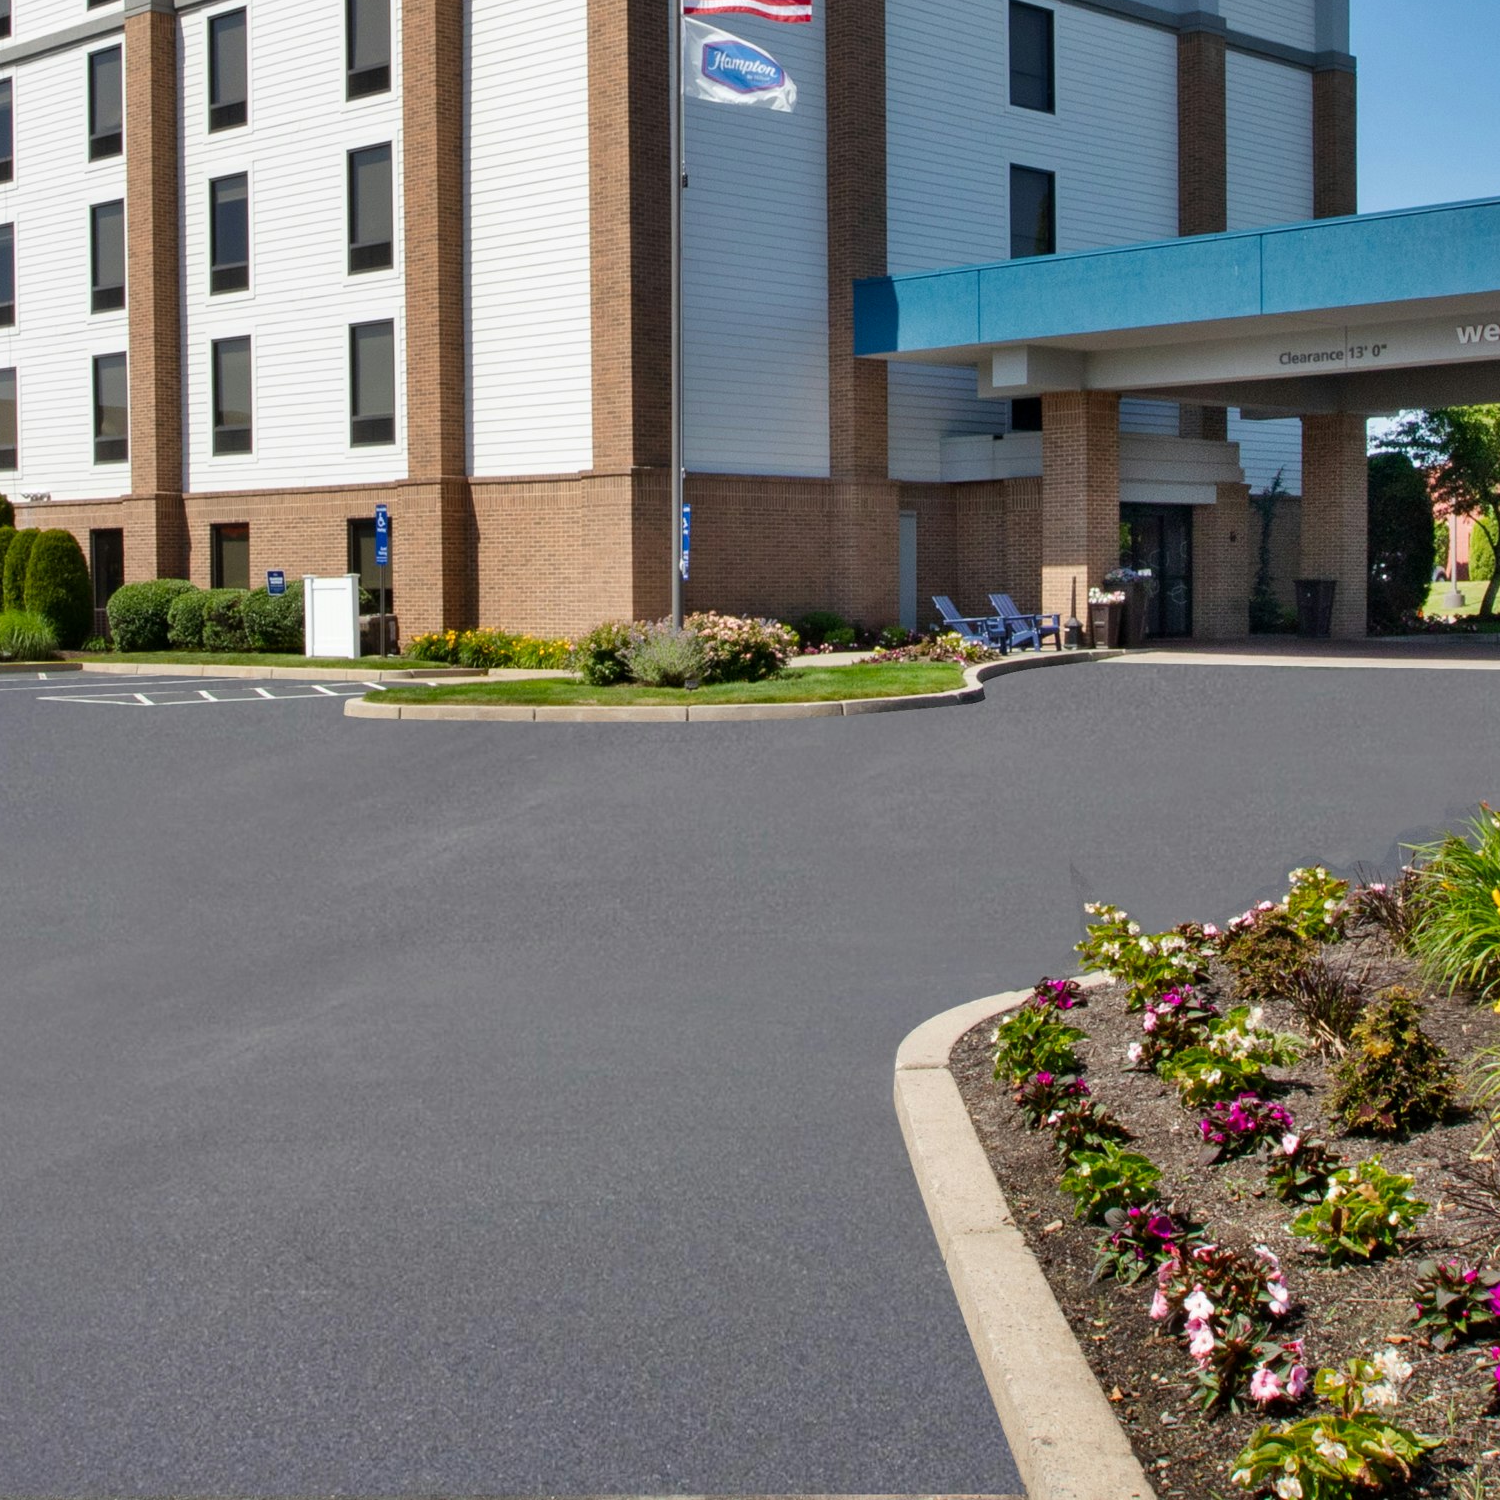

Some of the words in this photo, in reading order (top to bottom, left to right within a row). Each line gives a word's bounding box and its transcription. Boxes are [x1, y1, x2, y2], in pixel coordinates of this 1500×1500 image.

[707, 50, 779, 78] Hampton
[1279, 345, 1344, 365] Clearance
[1348, 345, 1368, 359] 13'
